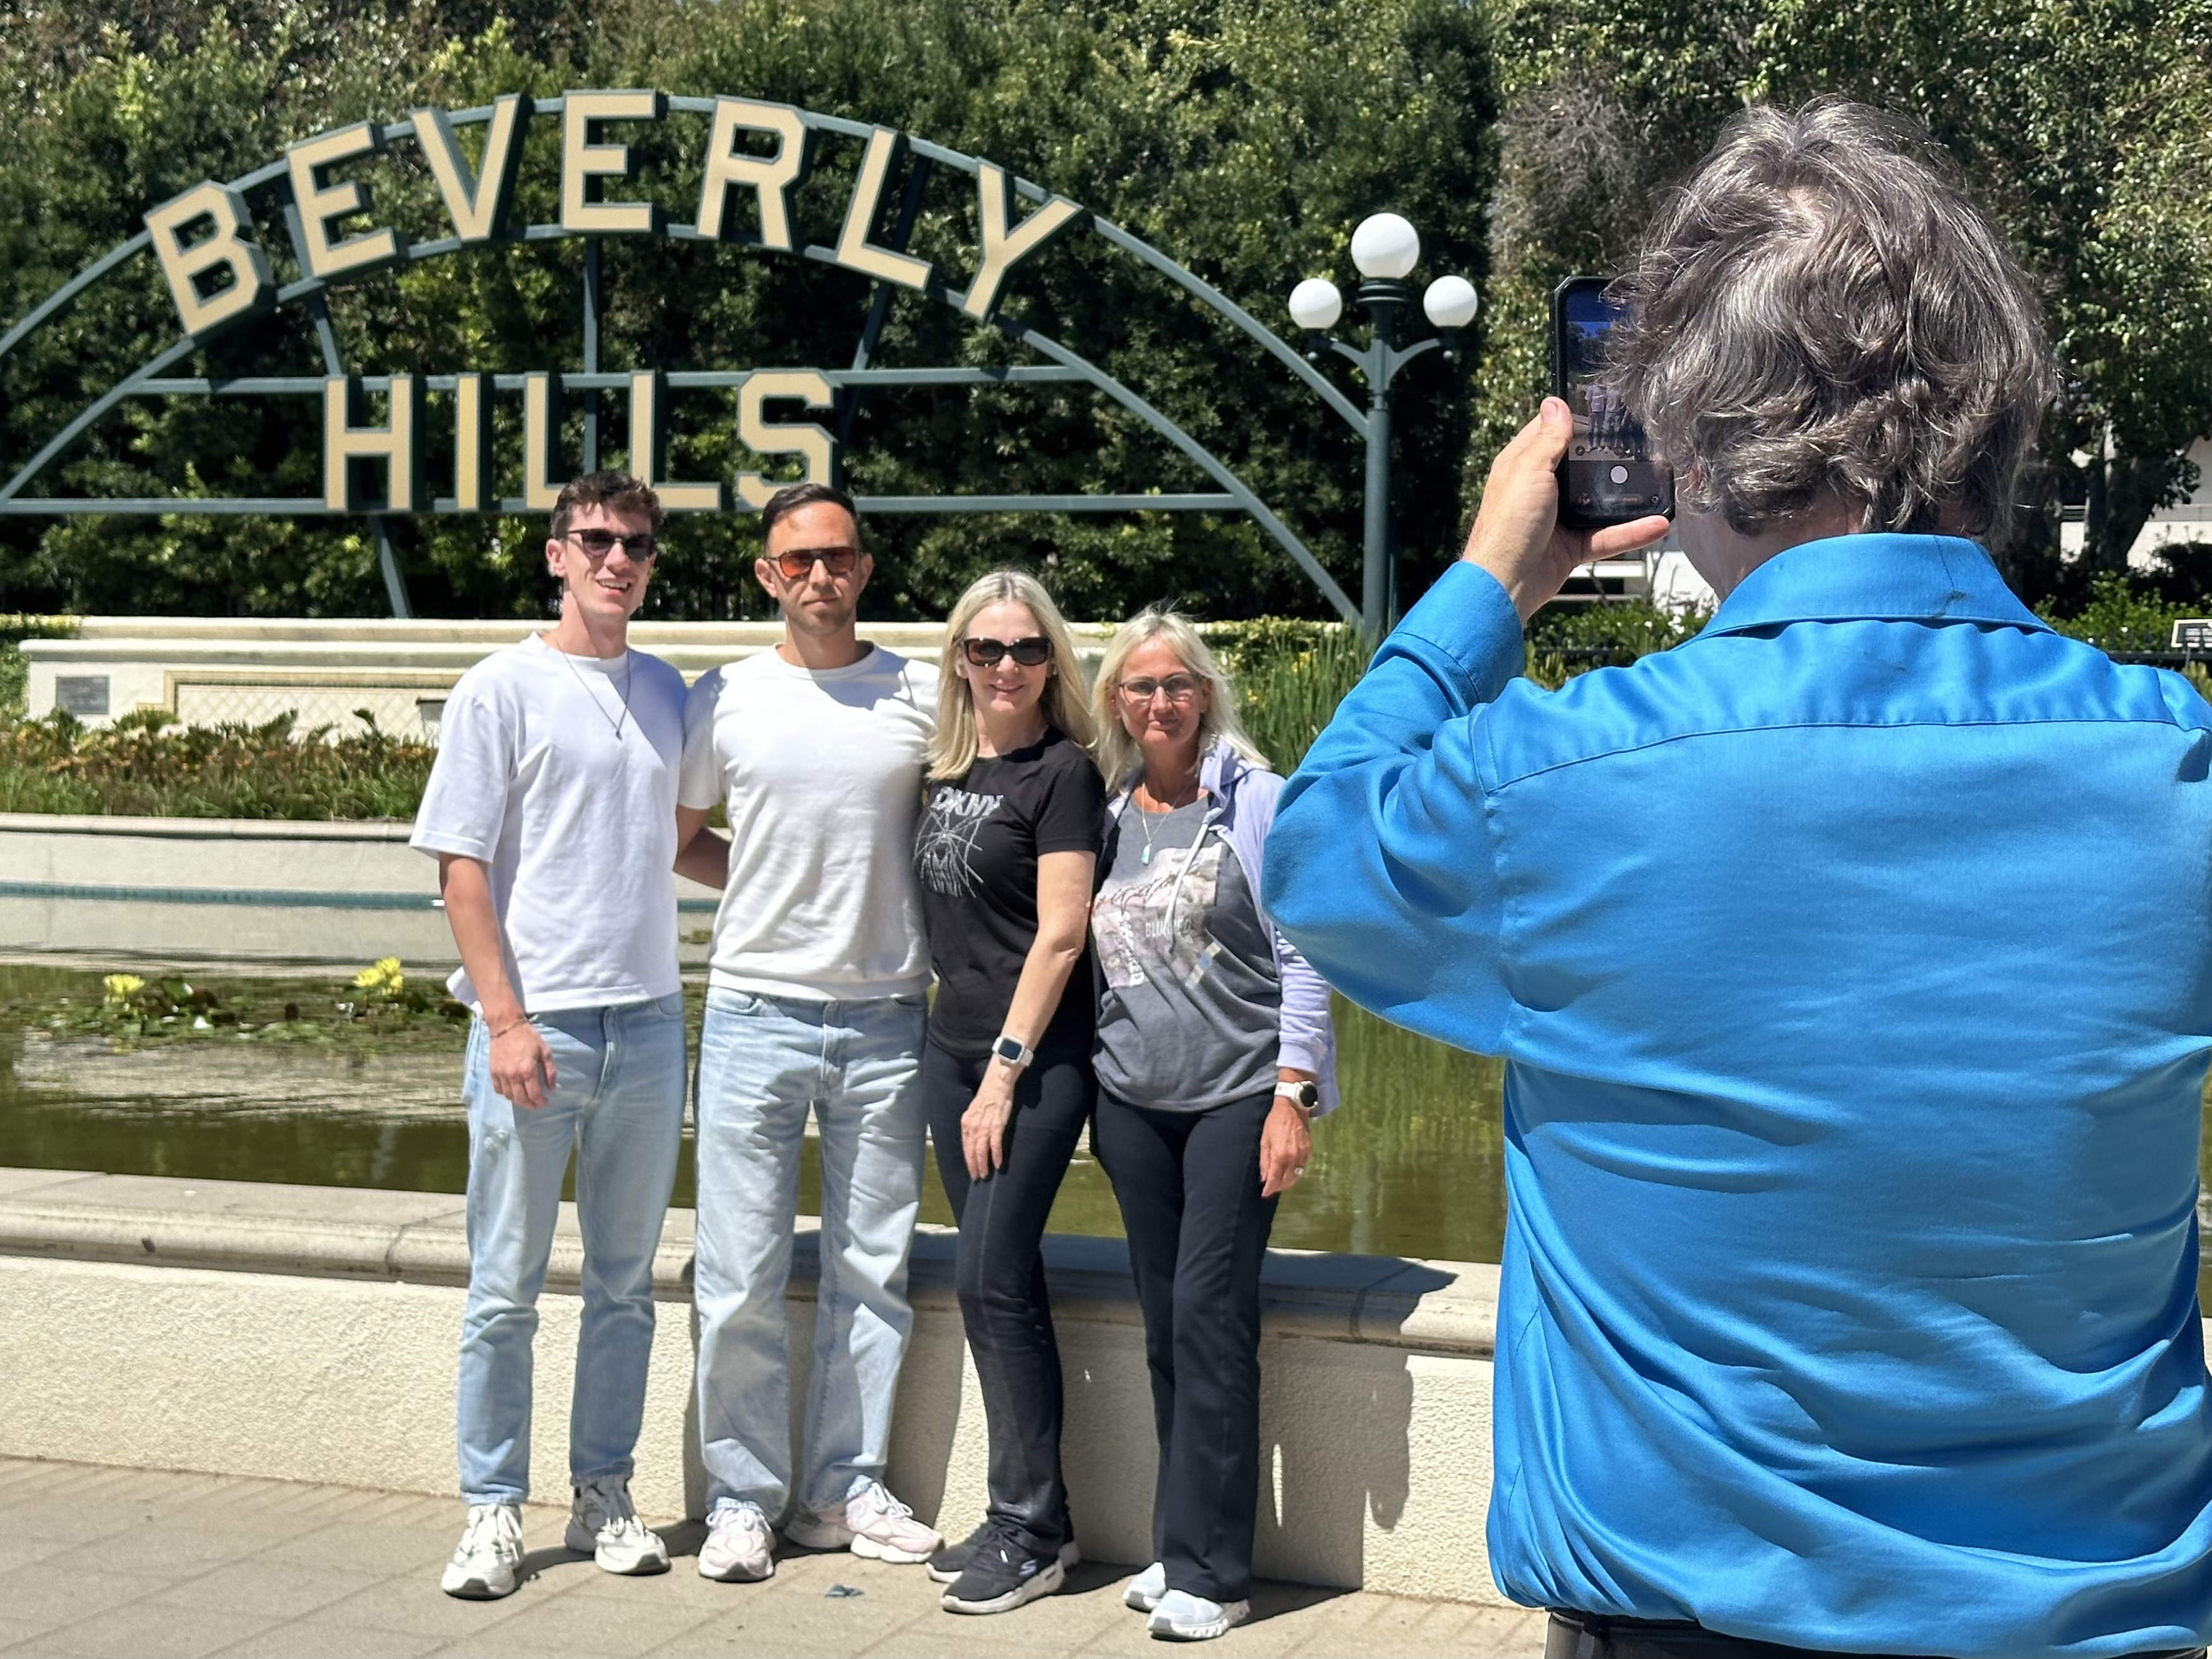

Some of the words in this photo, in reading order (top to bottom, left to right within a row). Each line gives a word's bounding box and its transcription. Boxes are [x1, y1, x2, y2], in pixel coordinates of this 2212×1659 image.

[144, 88, 1084, 335] BEVERLY
[323, 368, 839, 512] HILLS
[930, 786, 1004, 817] DKNY
